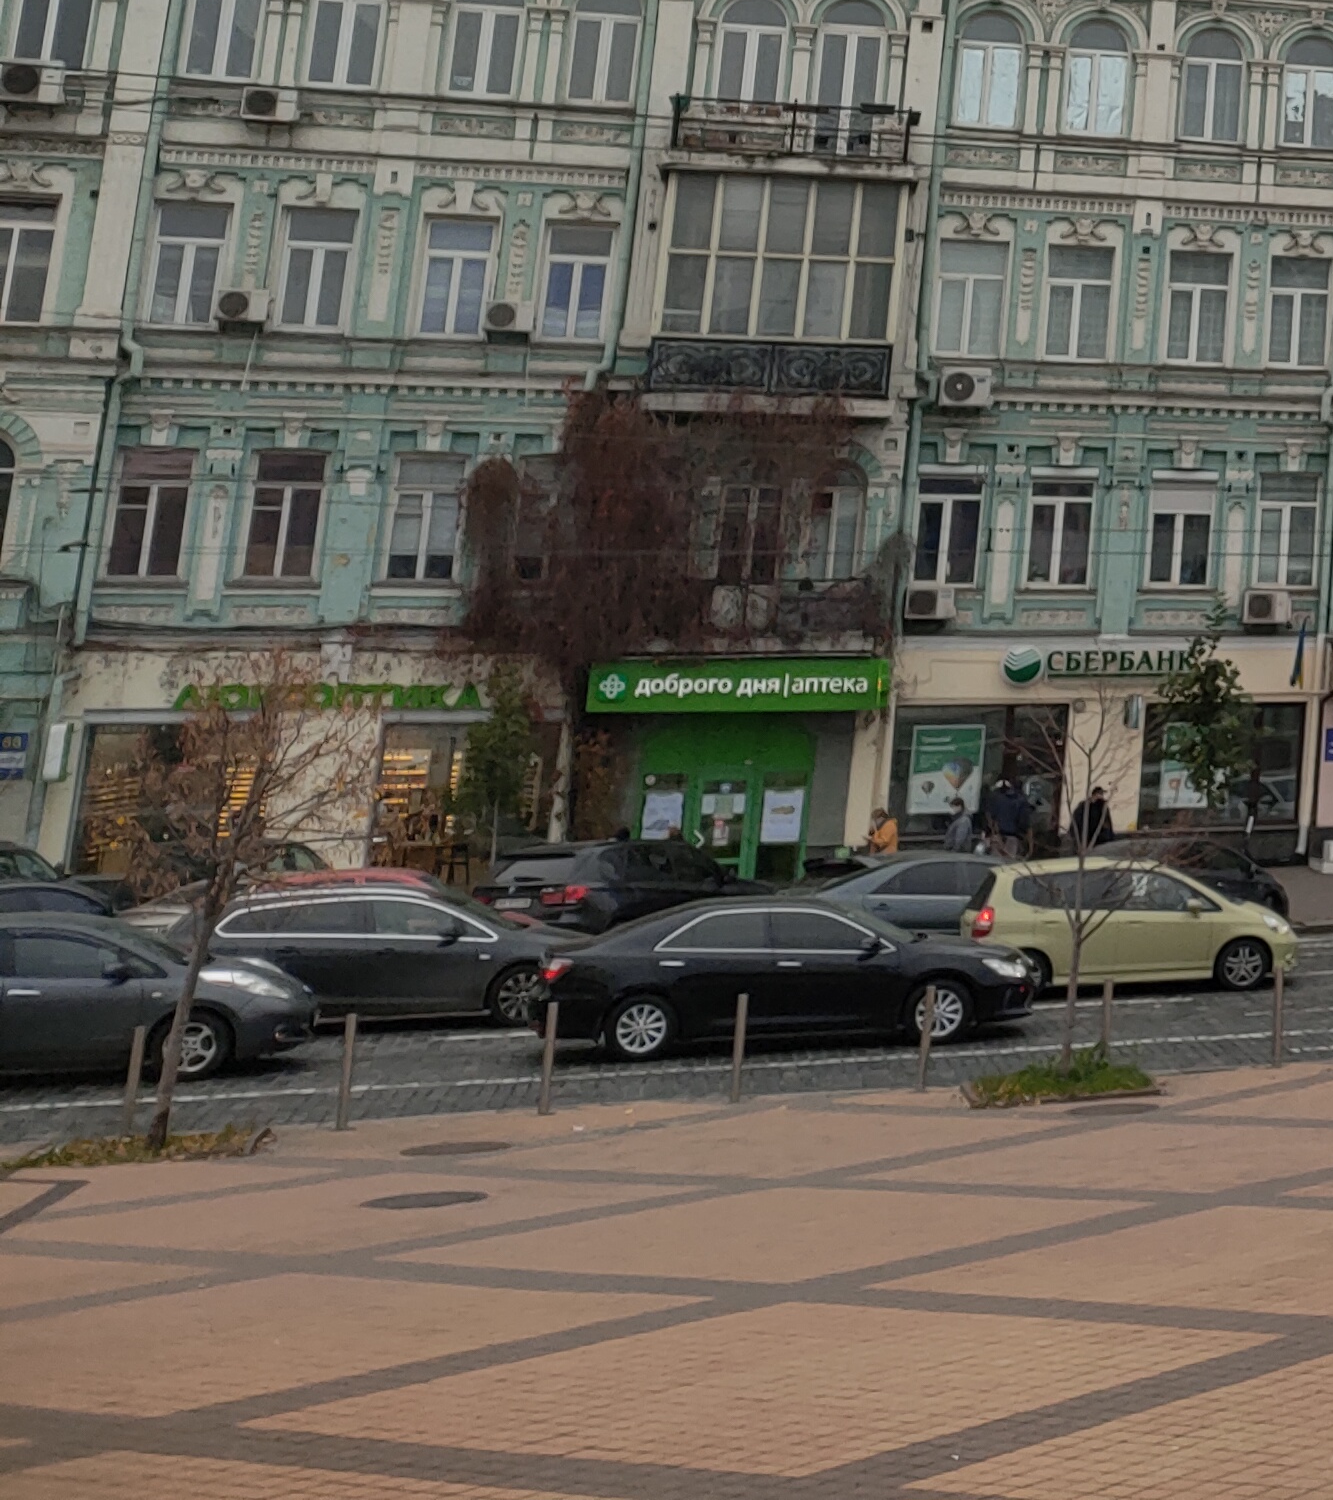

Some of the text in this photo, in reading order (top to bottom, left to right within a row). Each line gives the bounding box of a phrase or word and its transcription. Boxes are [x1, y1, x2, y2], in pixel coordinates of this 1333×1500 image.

[1047, 650, 1195, 672] СБЕРБАНК
[634, 673, 869, 698] доброго дня аптека
